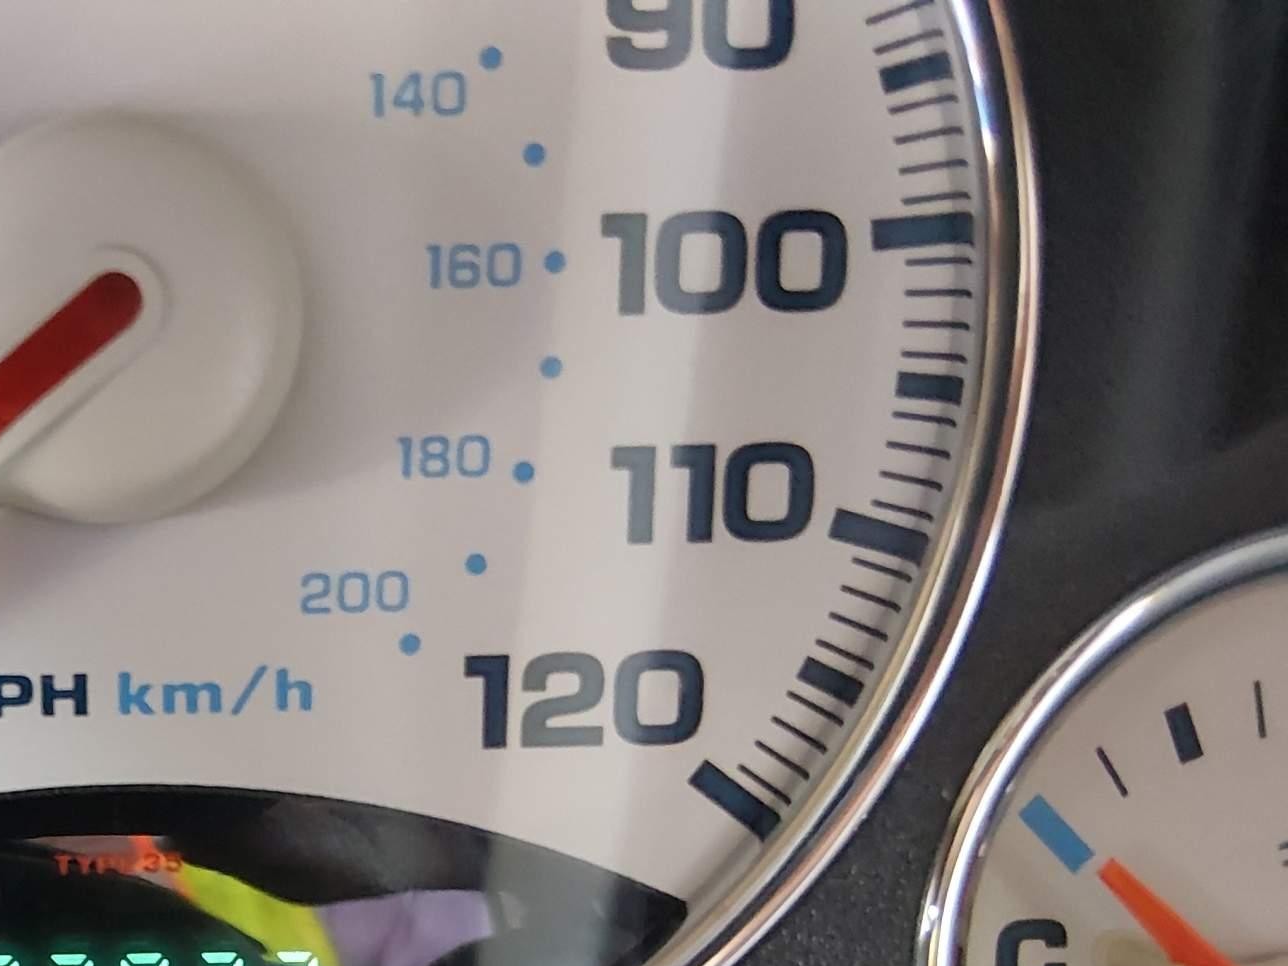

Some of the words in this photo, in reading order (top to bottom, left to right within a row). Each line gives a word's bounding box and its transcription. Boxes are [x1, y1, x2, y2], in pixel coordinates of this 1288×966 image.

[606, 0, 796, 70] 90
[369, 69, 468, 119] 140
[425, 241, 523, 290] 160
[602, 208, 849, 315] 100
[395, 433, 492, 480] 180
[613, 440, 816, 544] 110
[299, 569, 410, 616] 200
[117, 664, 313, 717] km/h
[463, 649, 705, 750] 120
